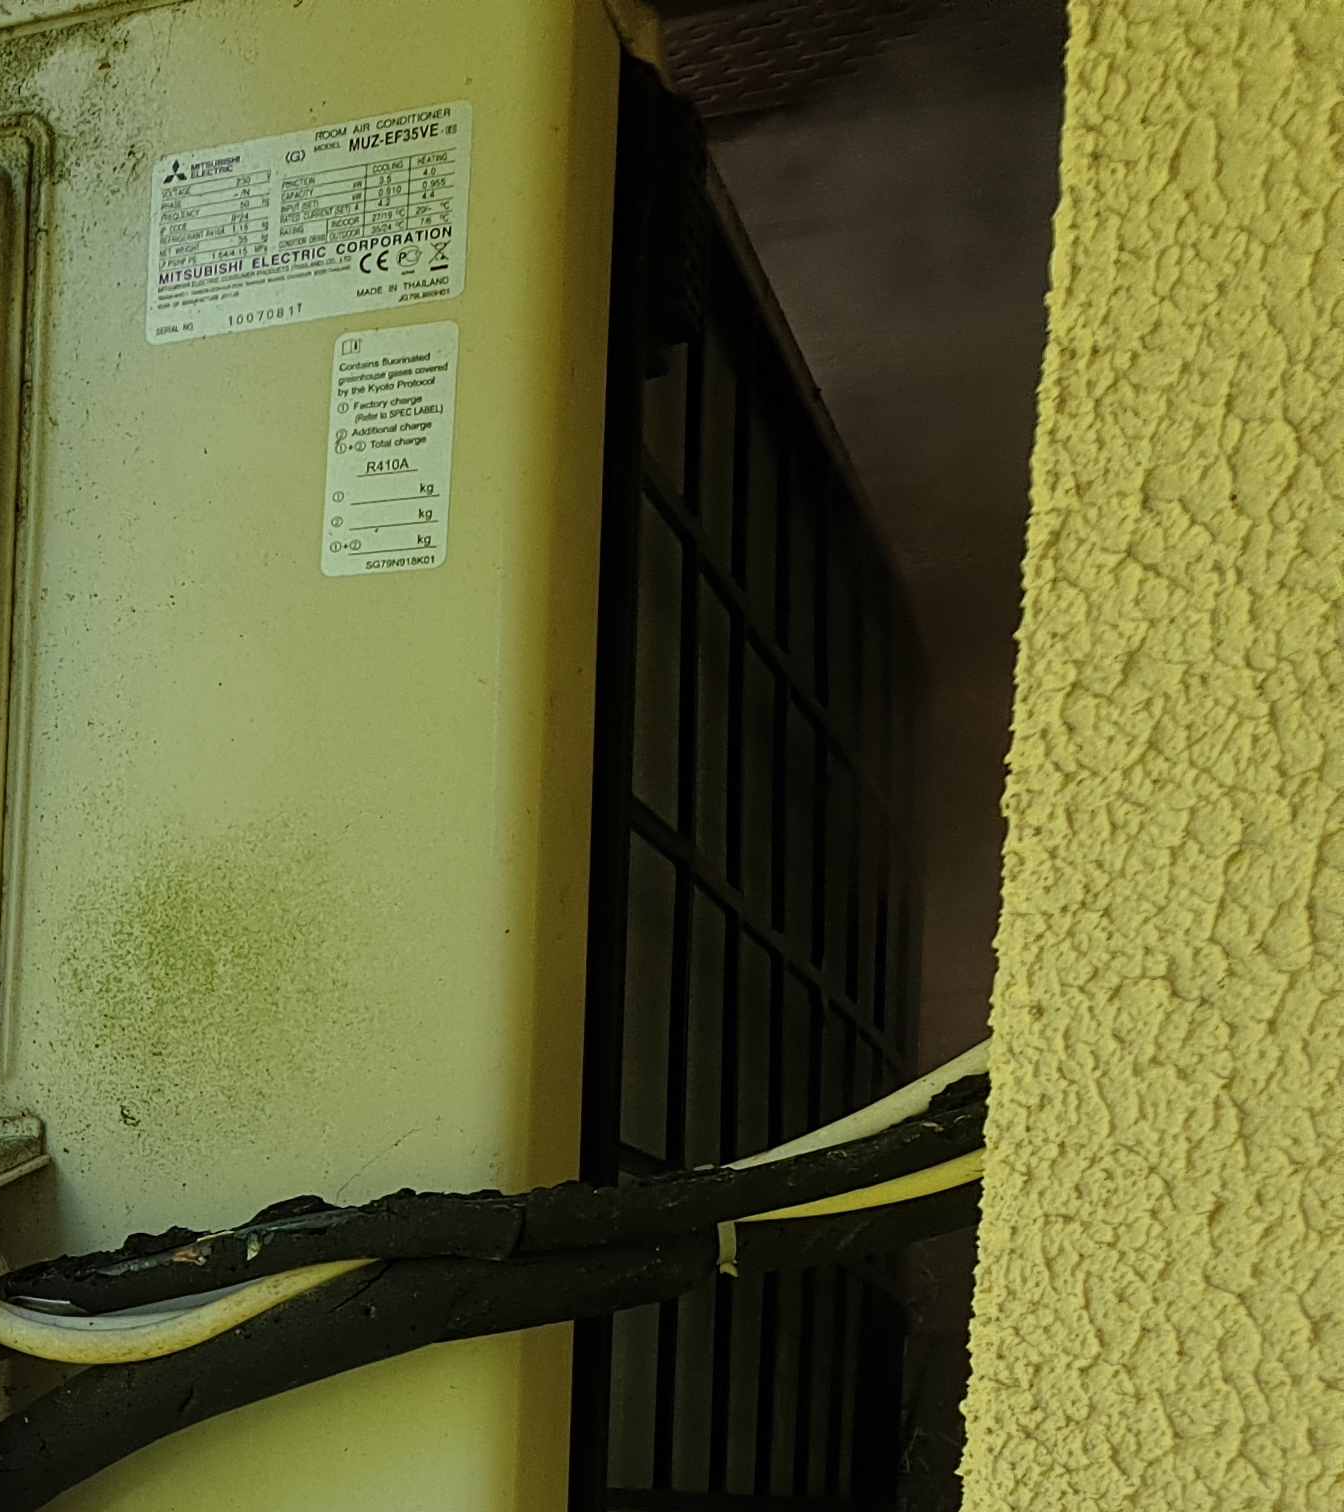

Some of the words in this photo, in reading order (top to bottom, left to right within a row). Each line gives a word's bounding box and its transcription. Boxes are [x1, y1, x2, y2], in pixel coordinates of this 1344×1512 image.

[315, 127, 347, 142] ROOM
[353, 122, 370, 135] AIR
[376, 107, 452, 130] CONDITIONER
[313, 141, 342, 152] MODEL
[349, 122, 439, 152] MUZ-EF35VE
[190, 155, 241, 171] MITSUBISHI
[285, 149, 306, 164] (G)
[373, 160, 403, 174] COOLING
[417, 152, 447, 165] HEATING
[190, 165, 234, 180] ELECTRIC
[281, 188, 314, 201] CAPACITY
[332, 216, 359, 228] INDOOR
[329, 228, 361, 240] OUTDOOR
[159, 259, 243, 285] MITSUBISHI
[252, 246, 326, 269] ELECTRIC
[336, 225, 452, 255] CORPORATION
[356, 285, 383, 298] MADE
[388, 283, 398, 293] IN
[403, 275, 450, 290] THAILAND
[339, 360, 380, 372] Contains
[382, 352, 431, 367] fluorinated
[338, 372, 386, 387] greenhouse
[388, 368, 413, 380] gases
[415, 362, 449, 375] covered
[337, 387, 349, 398] by
[351, 386, 365, 395] the
[368, 382, 394, 394] Kyoto
[396, 376, 435, 389] Protocol
[353, 400, 388, 411] Factory
[389, 396, 423, 407] charge
[354, 412, 378, 425] (Refer
[379, 411, 388, 420] to
[389, 408, 412, 419] SPEC
[414, 404, 444, 416] LABEL)
[351, 423, 397, 437] Additional
[399, 421, 432, 432] charge
[370, 438, 392, 449] Total
[394, 436, 427, 447] charge
[366, 457, 409, 473] R410A
[419, 482, 434, 495] kg
[418, 508, 433, 521] kg
[417, 534, 432, 547] kg
